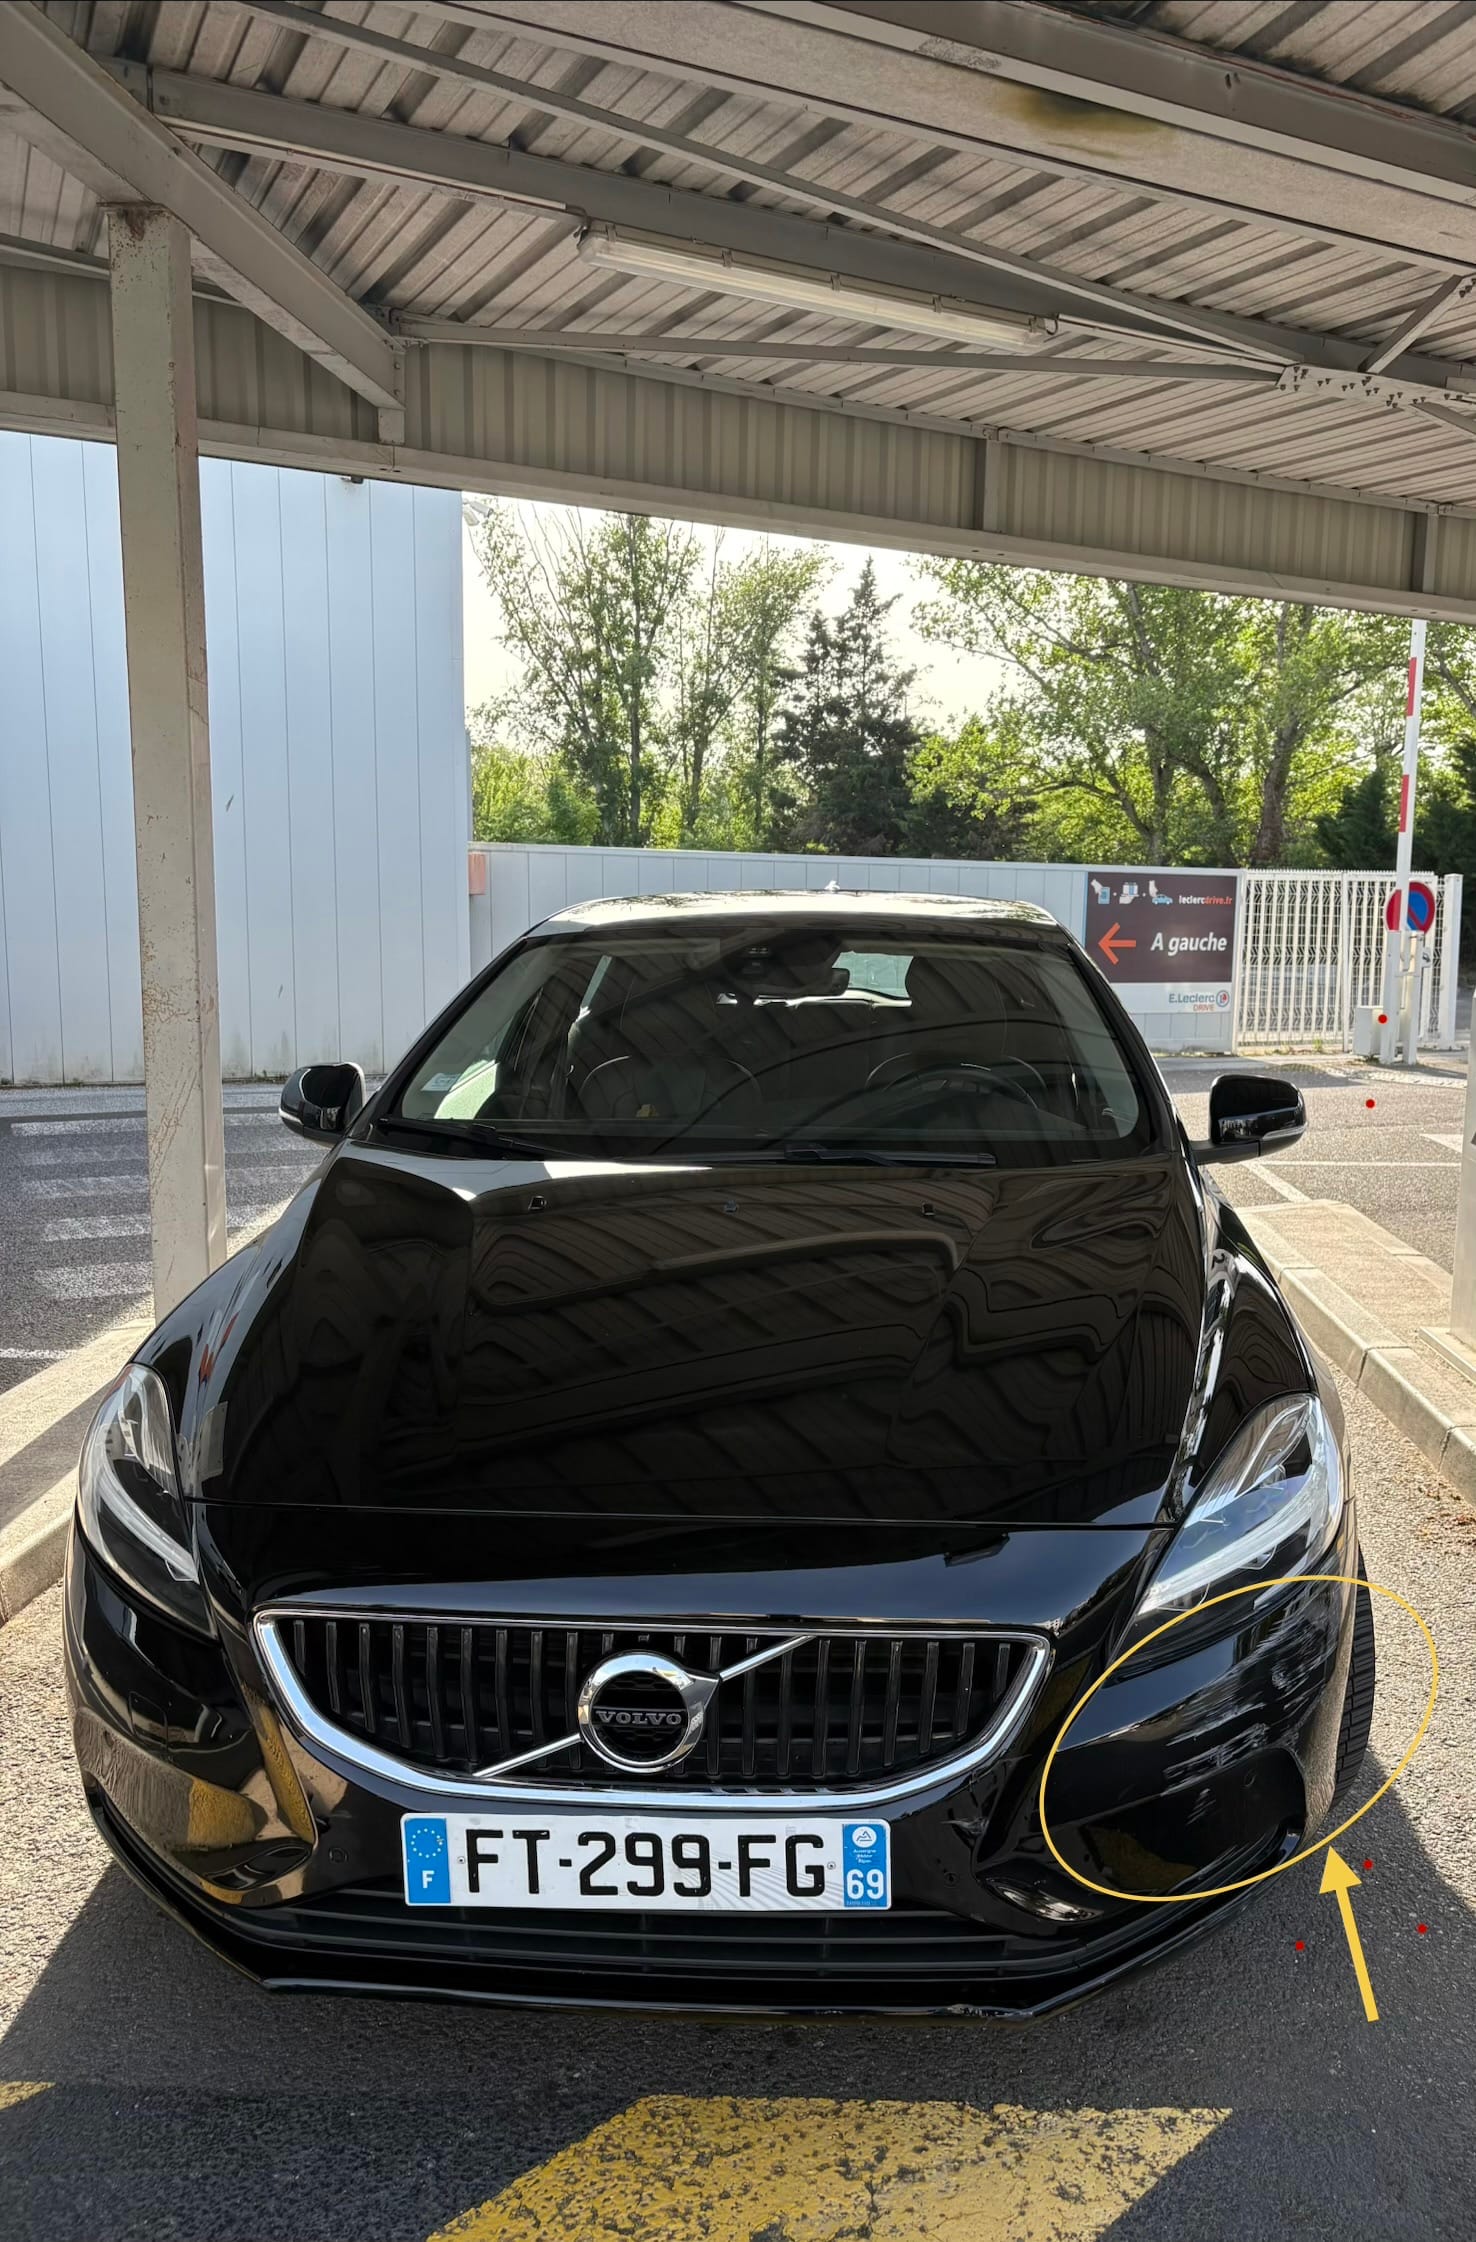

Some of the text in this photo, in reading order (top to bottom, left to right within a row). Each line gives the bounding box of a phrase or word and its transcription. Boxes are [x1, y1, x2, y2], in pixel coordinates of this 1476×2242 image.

[1178, 895, 1233, 905] leclercdrive.fr
[1150, 931, 1228, 957] A gauche
[1168, 993, 1215, 1004] E.Leclerc
[1193, 1003, 1215, 1011] DRIVE
[595, 1711, 682, 1726] VOLVO
[465, 1829, 826, 1897] FT-299-FG
[422, 1870, 435, 1889] F
[847, 1868, 884, 1900] 69
